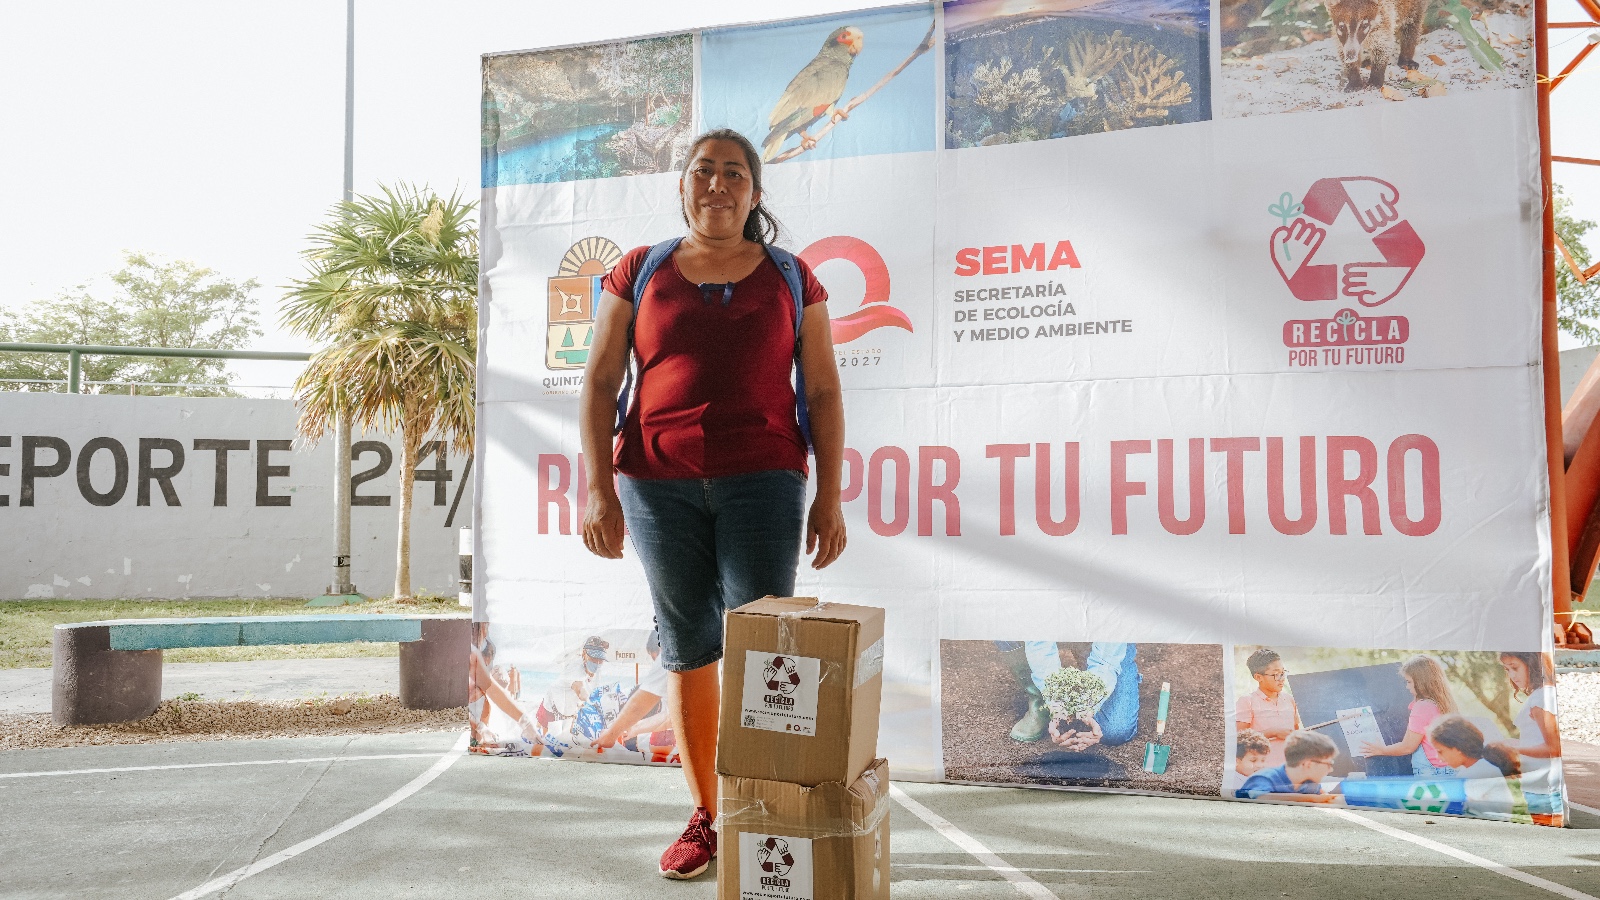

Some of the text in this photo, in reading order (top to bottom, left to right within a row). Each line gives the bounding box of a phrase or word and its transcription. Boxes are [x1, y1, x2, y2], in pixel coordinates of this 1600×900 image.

[954, 240, 1082, 277] SEMA
[954, 280, 1067, 303] SECRETARÍA
[954, 300, 1077, 323] DE ECOLOGÍA
[953, 319, 1133, 343] Y MEDIO AMBIENTE
[839, 356, 881, 367] 2027
[1288, 346, 1405, 367] POR TU FUTURO
[985, 441, 1081, 537] TU
[1110, 433, 1443, 537] FUTURO
